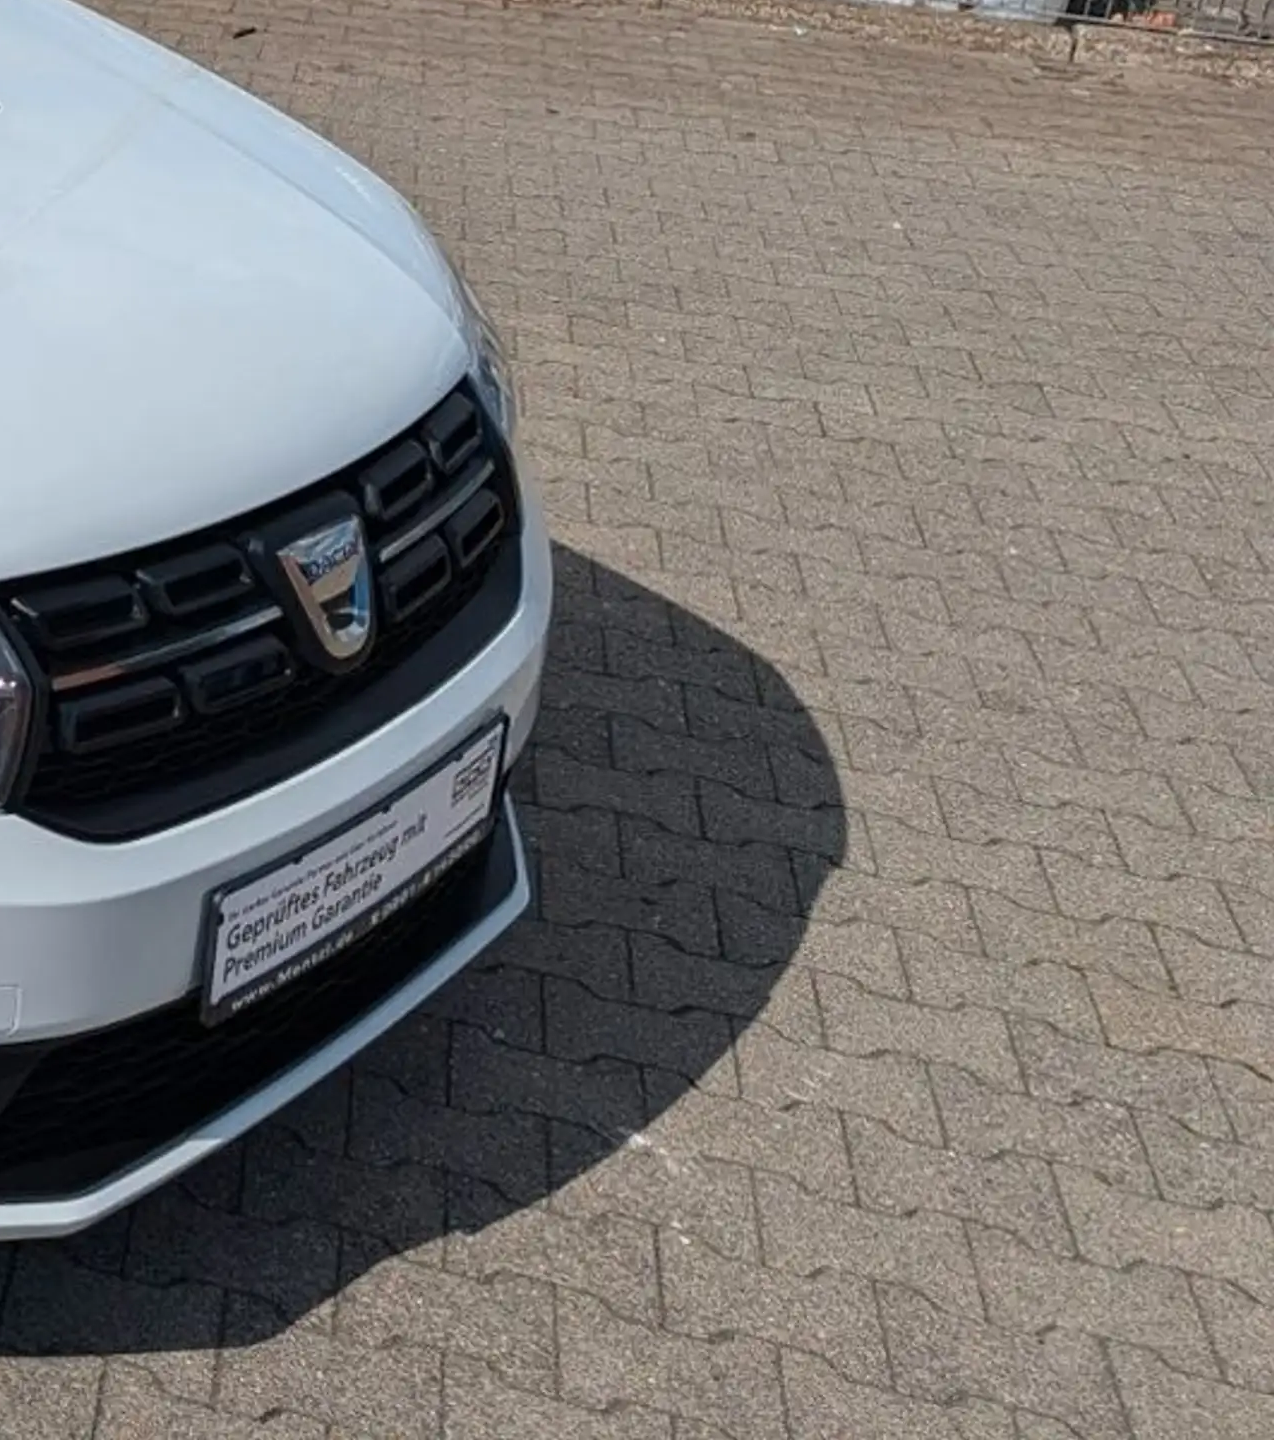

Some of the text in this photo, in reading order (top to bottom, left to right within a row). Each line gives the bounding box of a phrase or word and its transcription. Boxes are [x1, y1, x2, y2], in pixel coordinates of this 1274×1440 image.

[223, 920, 307, 983] Premium
[311, 872, 383, 930] Garantie
[227, 886, 320, 950] Geprüftes
[324, 835, 398, 897] Fahrzeug
[400, 812, 427, 847] mit
